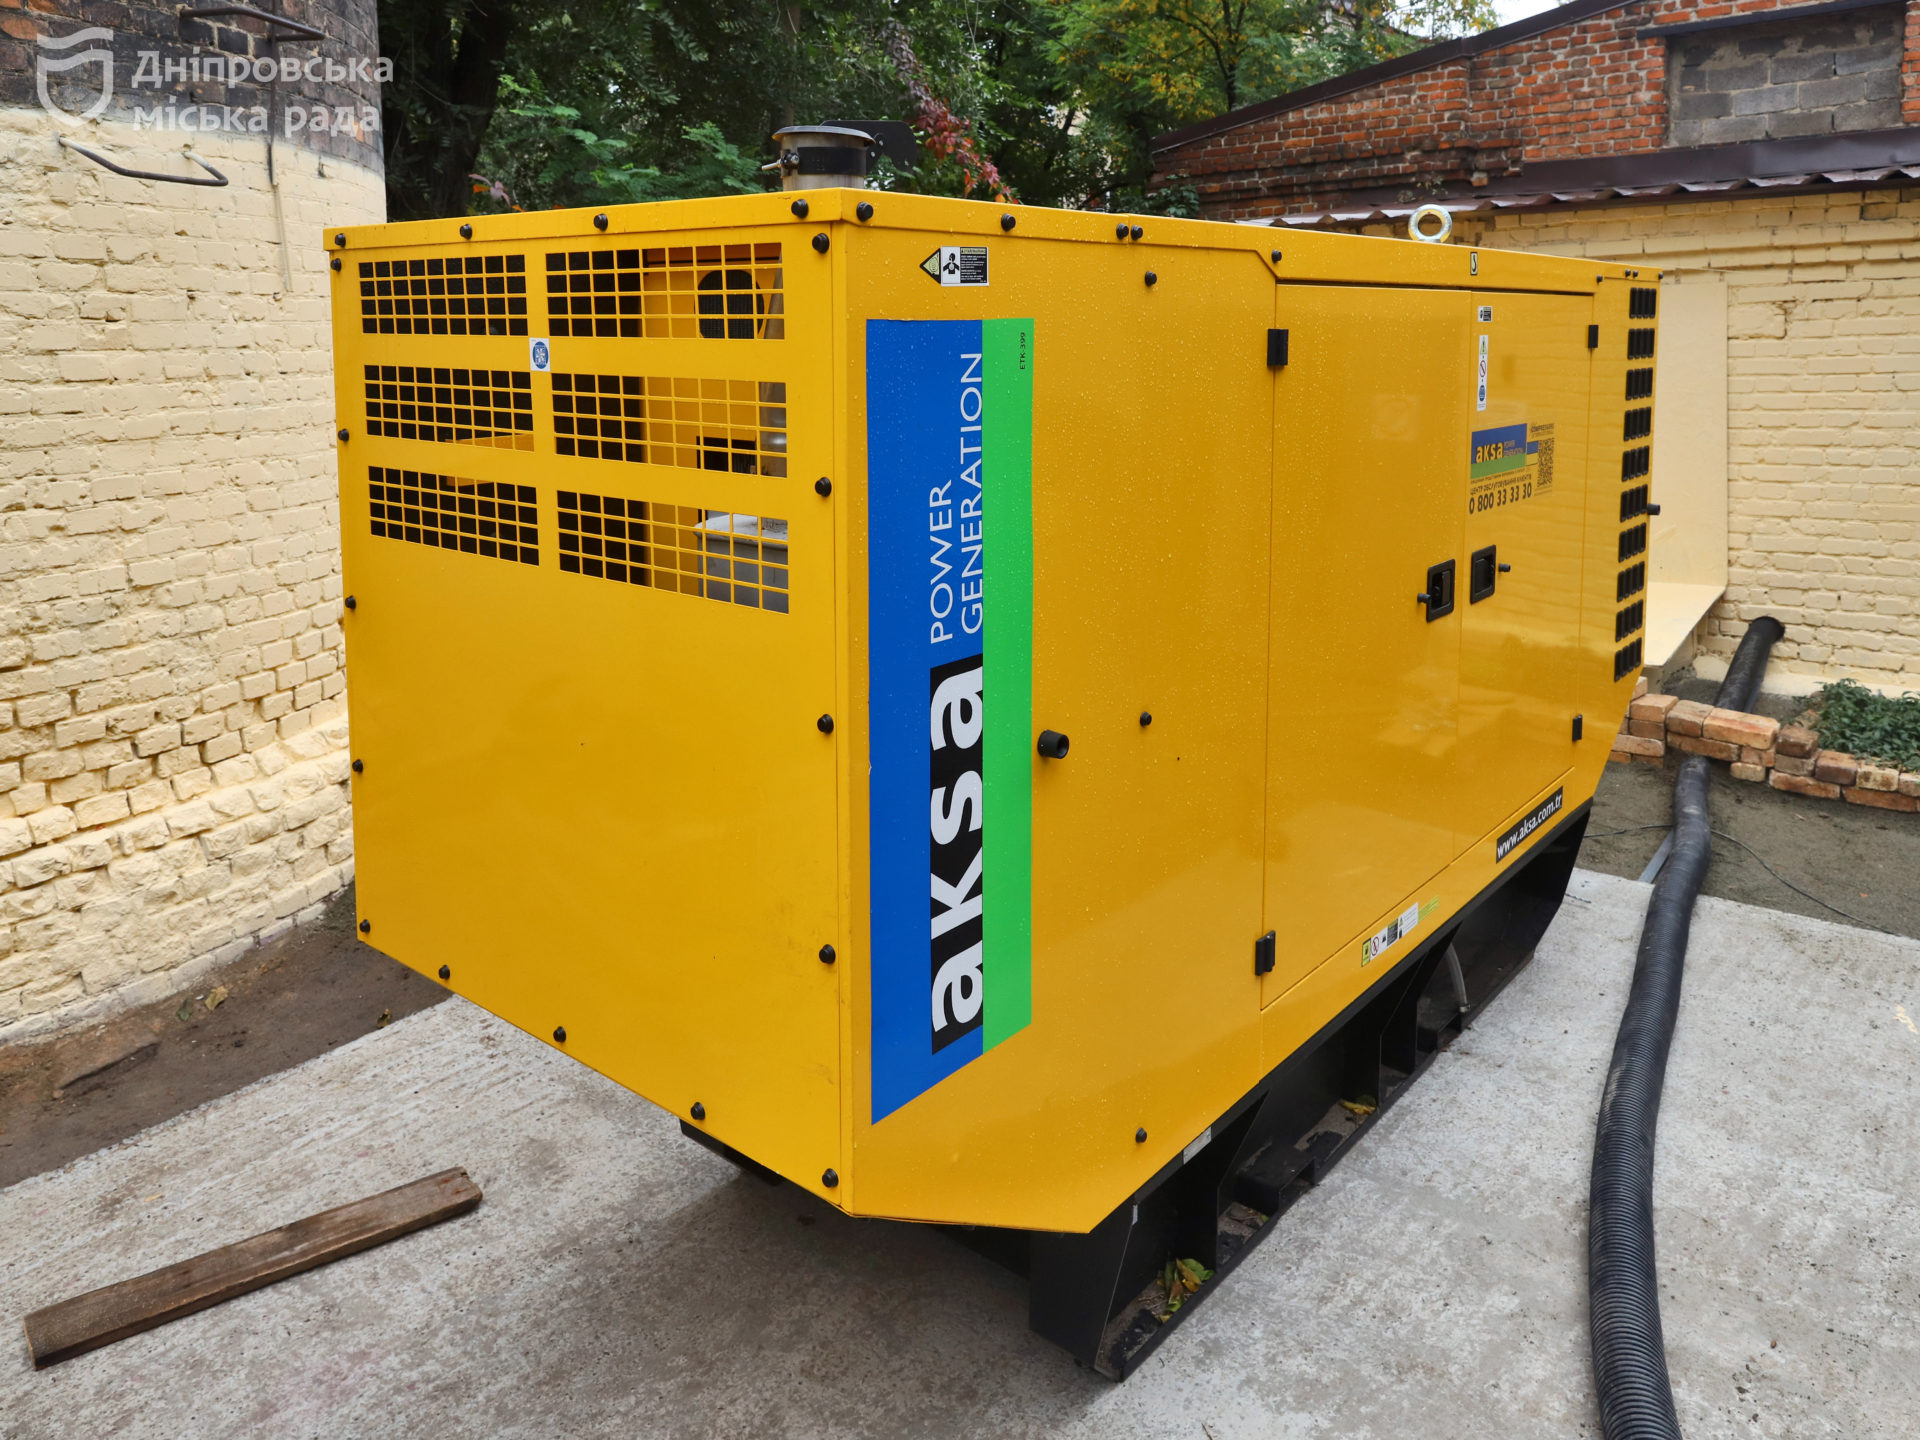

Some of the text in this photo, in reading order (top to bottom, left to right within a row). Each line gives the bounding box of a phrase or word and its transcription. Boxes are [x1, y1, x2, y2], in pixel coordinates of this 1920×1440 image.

[960, 353, 983, 634] GENERATION
[1469, 497, 1475, 515] 0
[1477, 492, 1494, 512] 800
[1497, 488, 1507, 507] 33
[1510, 485, 1520, 503] 33
[1522, 482, 1532, 500] 30
[1475, 442, 1504, 463] aksa
[930, 479, 953, 644] POWER
[930, 665, 983, 1033] aksa
[1497, 793, 1562, 859] www.aksa.com.tr
